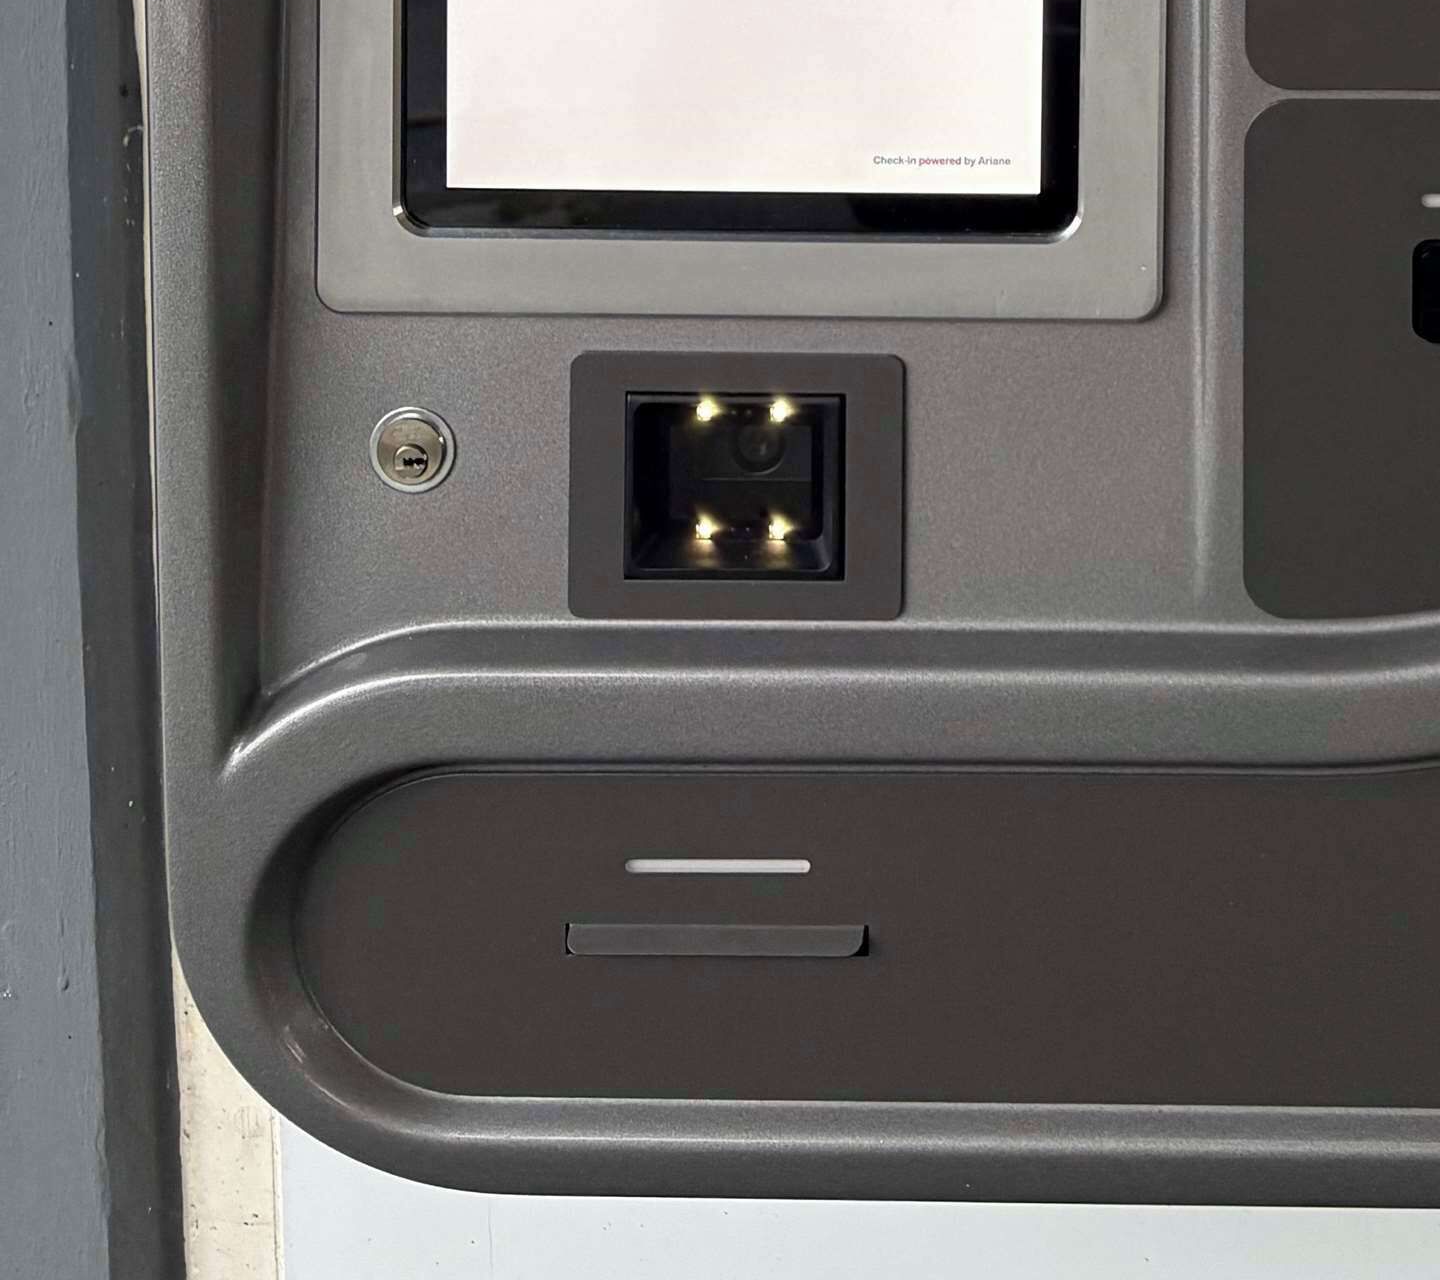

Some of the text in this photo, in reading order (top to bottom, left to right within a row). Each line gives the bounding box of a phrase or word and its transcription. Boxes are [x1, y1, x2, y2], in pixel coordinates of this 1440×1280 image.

[872, 155, 1012, 168] Check-in powered by Ariane
